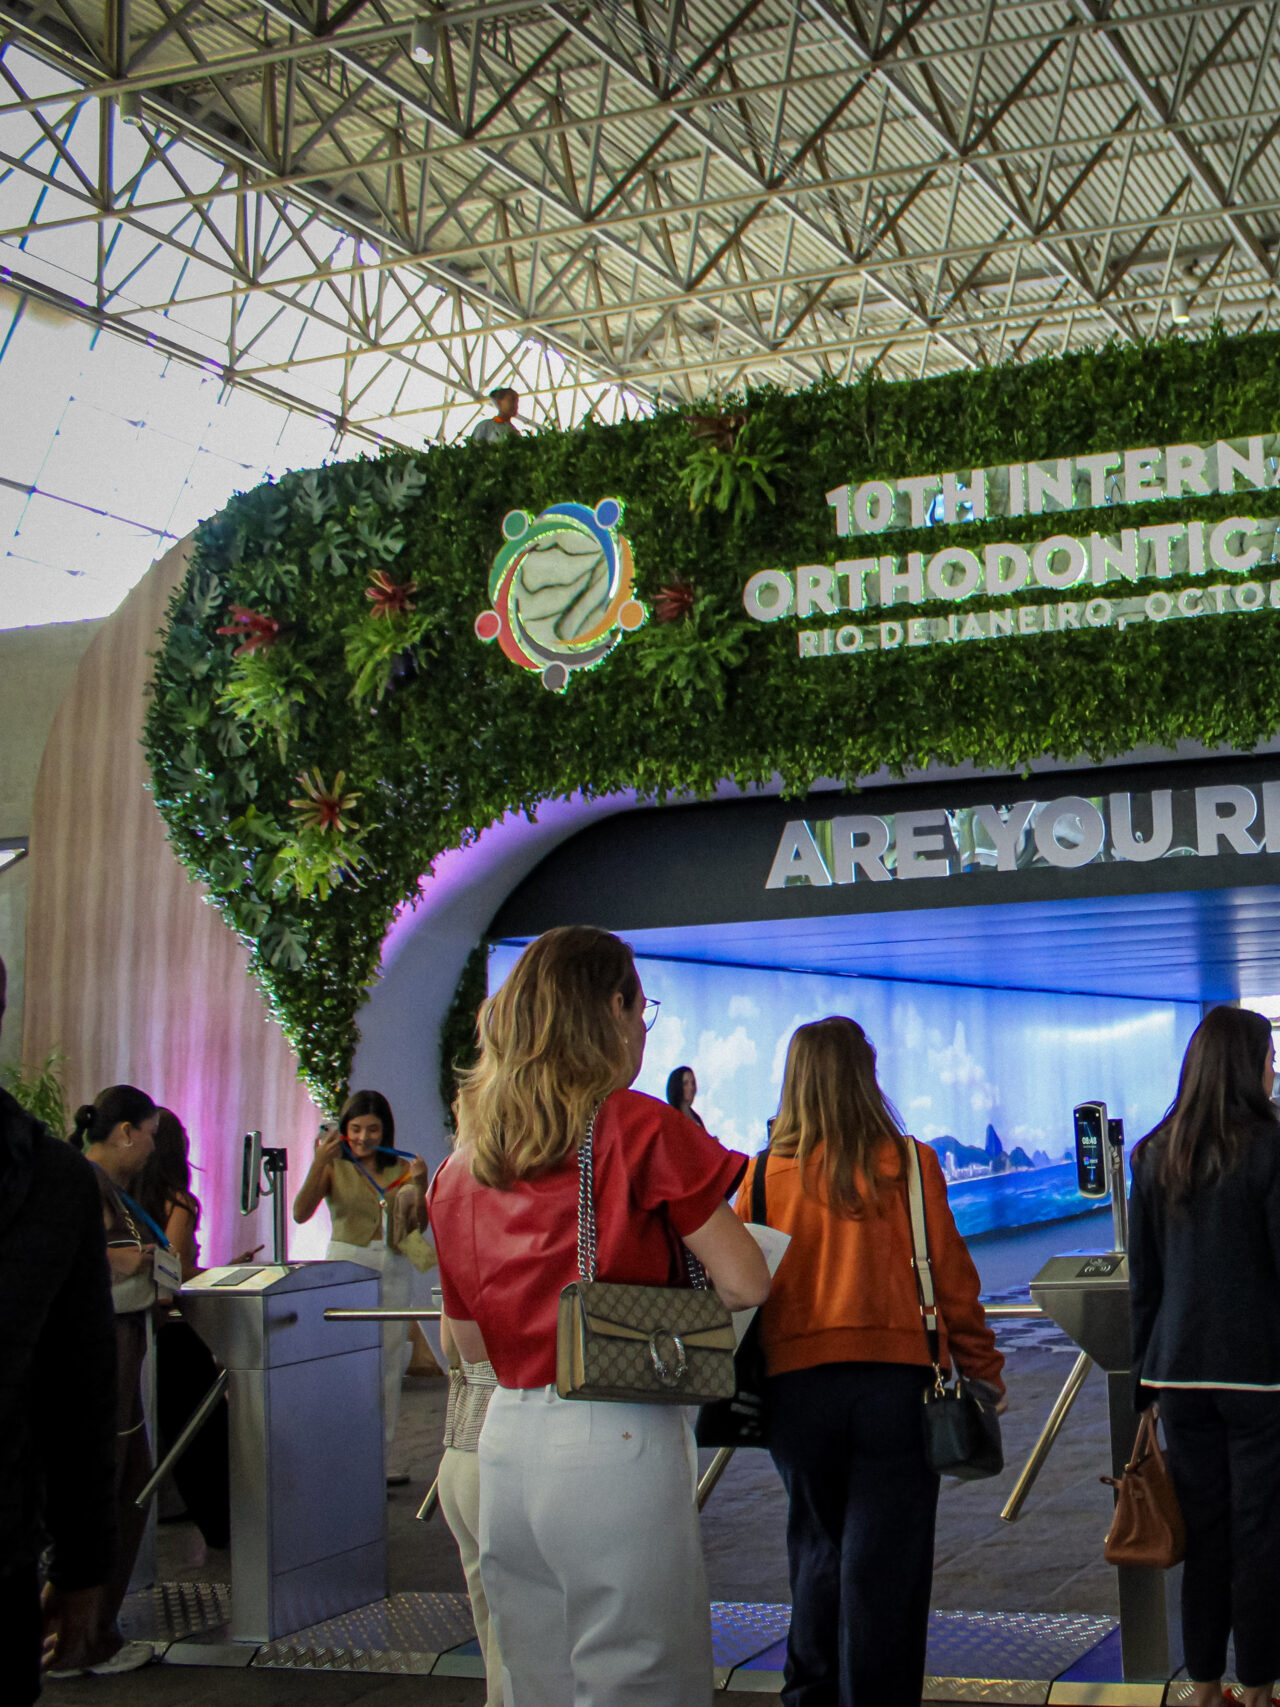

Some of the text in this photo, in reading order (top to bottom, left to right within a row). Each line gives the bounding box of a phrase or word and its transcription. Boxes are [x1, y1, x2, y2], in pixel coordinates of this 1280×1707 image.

[826, 469, 987, 536] 10TH
[743, 516, 1262, 621] ORTHODONTIC
[799, 625, 863, 658] RIO
[880, 617, 929, 650] DE
[947, 601, 1127, 643] JANEIRO,
[765, 809, 951, 889] ARE
[976, 789, 1173, 872] YOU
